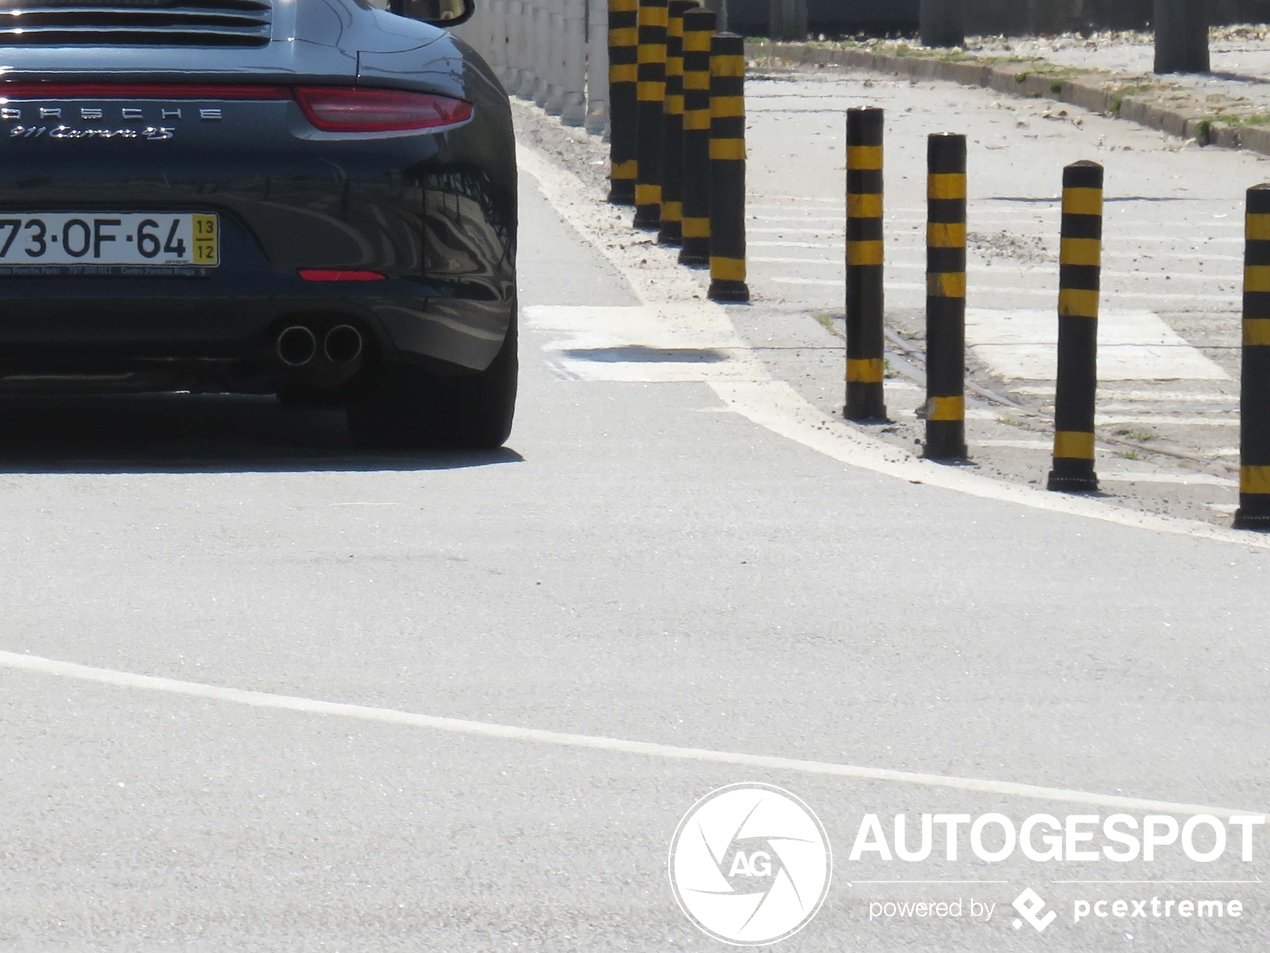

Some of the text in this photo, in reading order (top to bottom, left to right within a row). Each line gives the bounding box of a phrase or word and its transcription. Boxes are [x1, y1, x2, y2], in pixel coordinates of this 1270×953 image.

[10, 125, 46, 138] 911
[196, 220, 214, 234] 13
[197, 246, 214, 259] 12
